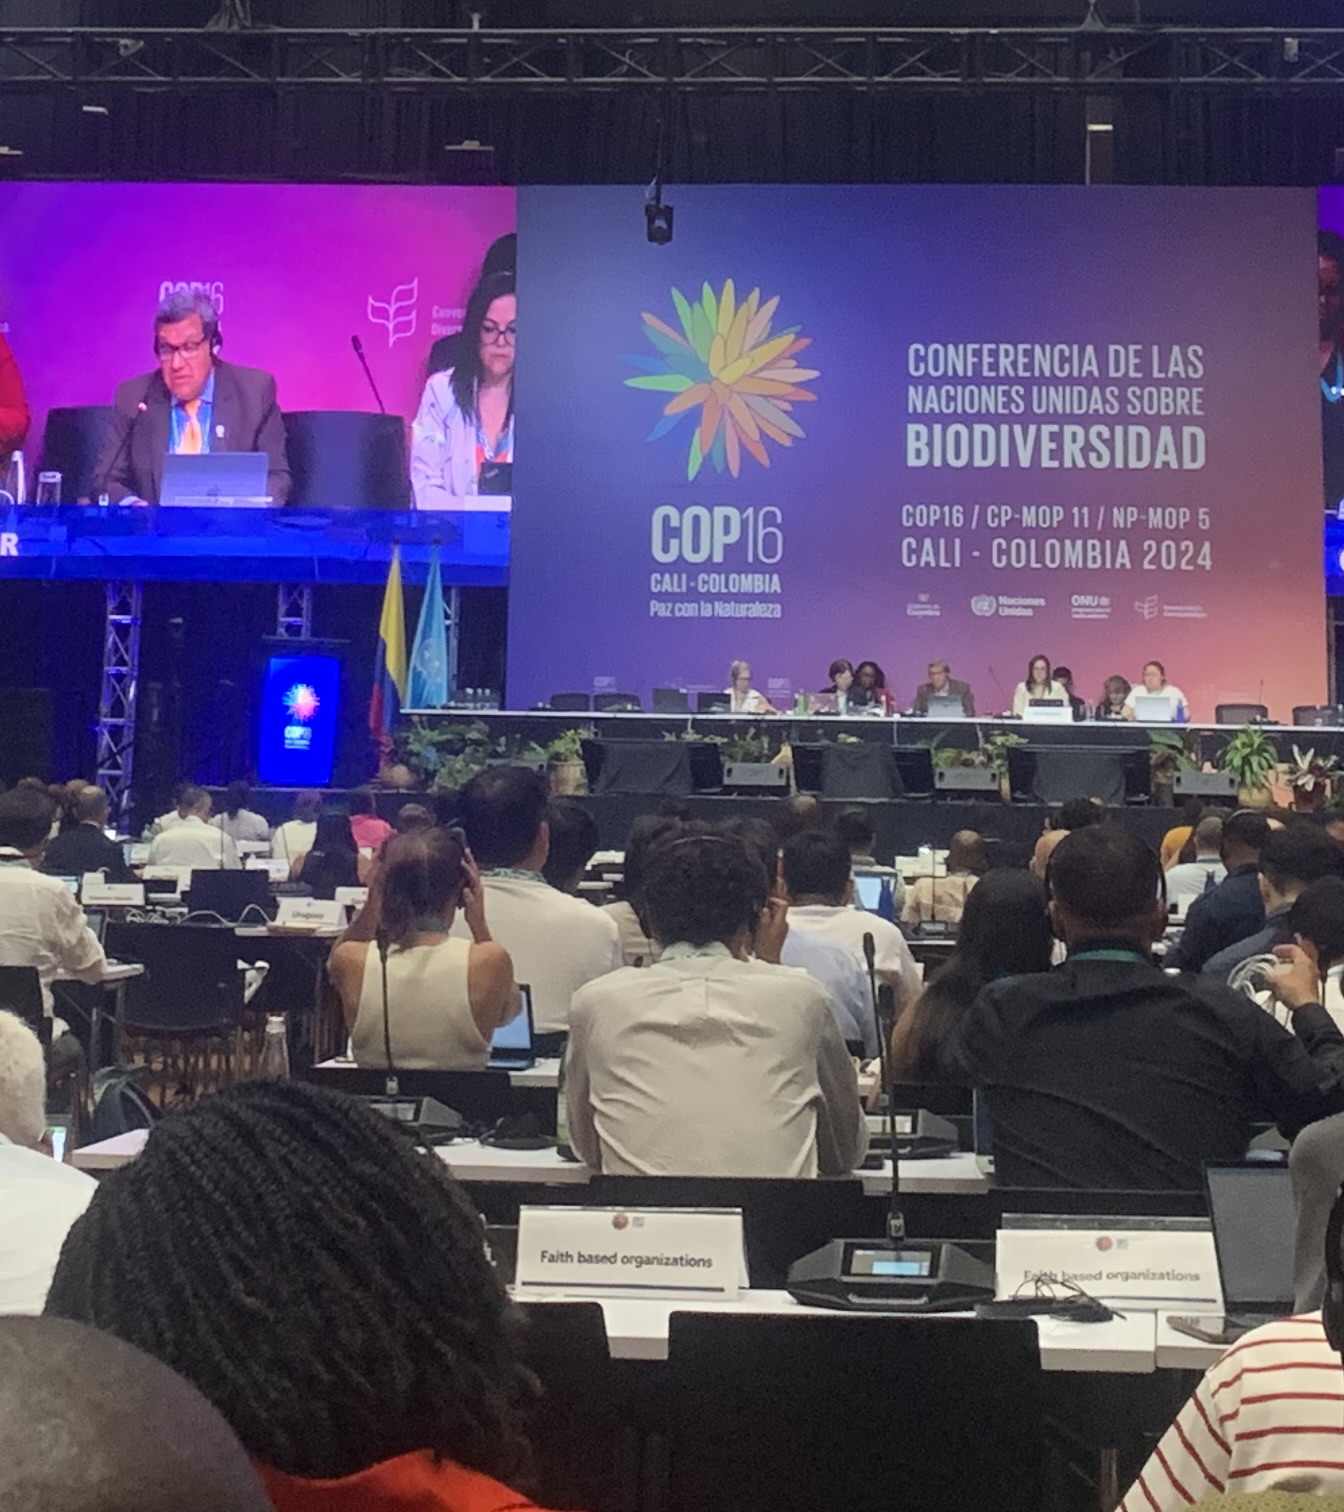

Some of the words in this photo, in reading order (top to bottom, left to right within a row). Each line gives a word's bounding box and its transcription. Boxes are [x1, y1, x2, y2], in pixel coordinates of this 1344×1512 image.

[907, 343, 1100, 378] CONFERENCIA
[1107, 344, 1143, 378] DE
[1151, 345, 1205, 379] LAS
[907, 385, 1025, 415] NACIONES
[1032, 386, 1120, 416] UNIDAS
[1126, 387, 1205, 416] SOBRE
[906, 423, 1207, 470] BIODIVERSIDAD
[901, 505, 964, 528] COP16
[986, 505, 1064, 529] CP-MOP
[1071, 506, 1090, 528] 11
[1112, 507, 1191, 530] NP-MOP
[1197, 507, 1211, 530] 5
[651, 504, 784, 564] COP16
[901, 538, 961, 569] CALI
[991, 538, 1132, 569] COLOMBIA
[1142, 540, 1213, 571] 2024
[649, 600, 673, 617] Paz
[675, 602, 699, 617] con
[700, 600, 713, 617] la
[714, 600, 782, 618] Naturaleza
[998, 595, 1046, 607] Naciones
[1071, 594, 1098, 607] ONU
[540, 1250, 574, 1264] Faith
[578, 1251, 617, 1265] based
[620, 1254, 712, 1268] organizations
[1106, 1270, 1200, 1282] organizations
